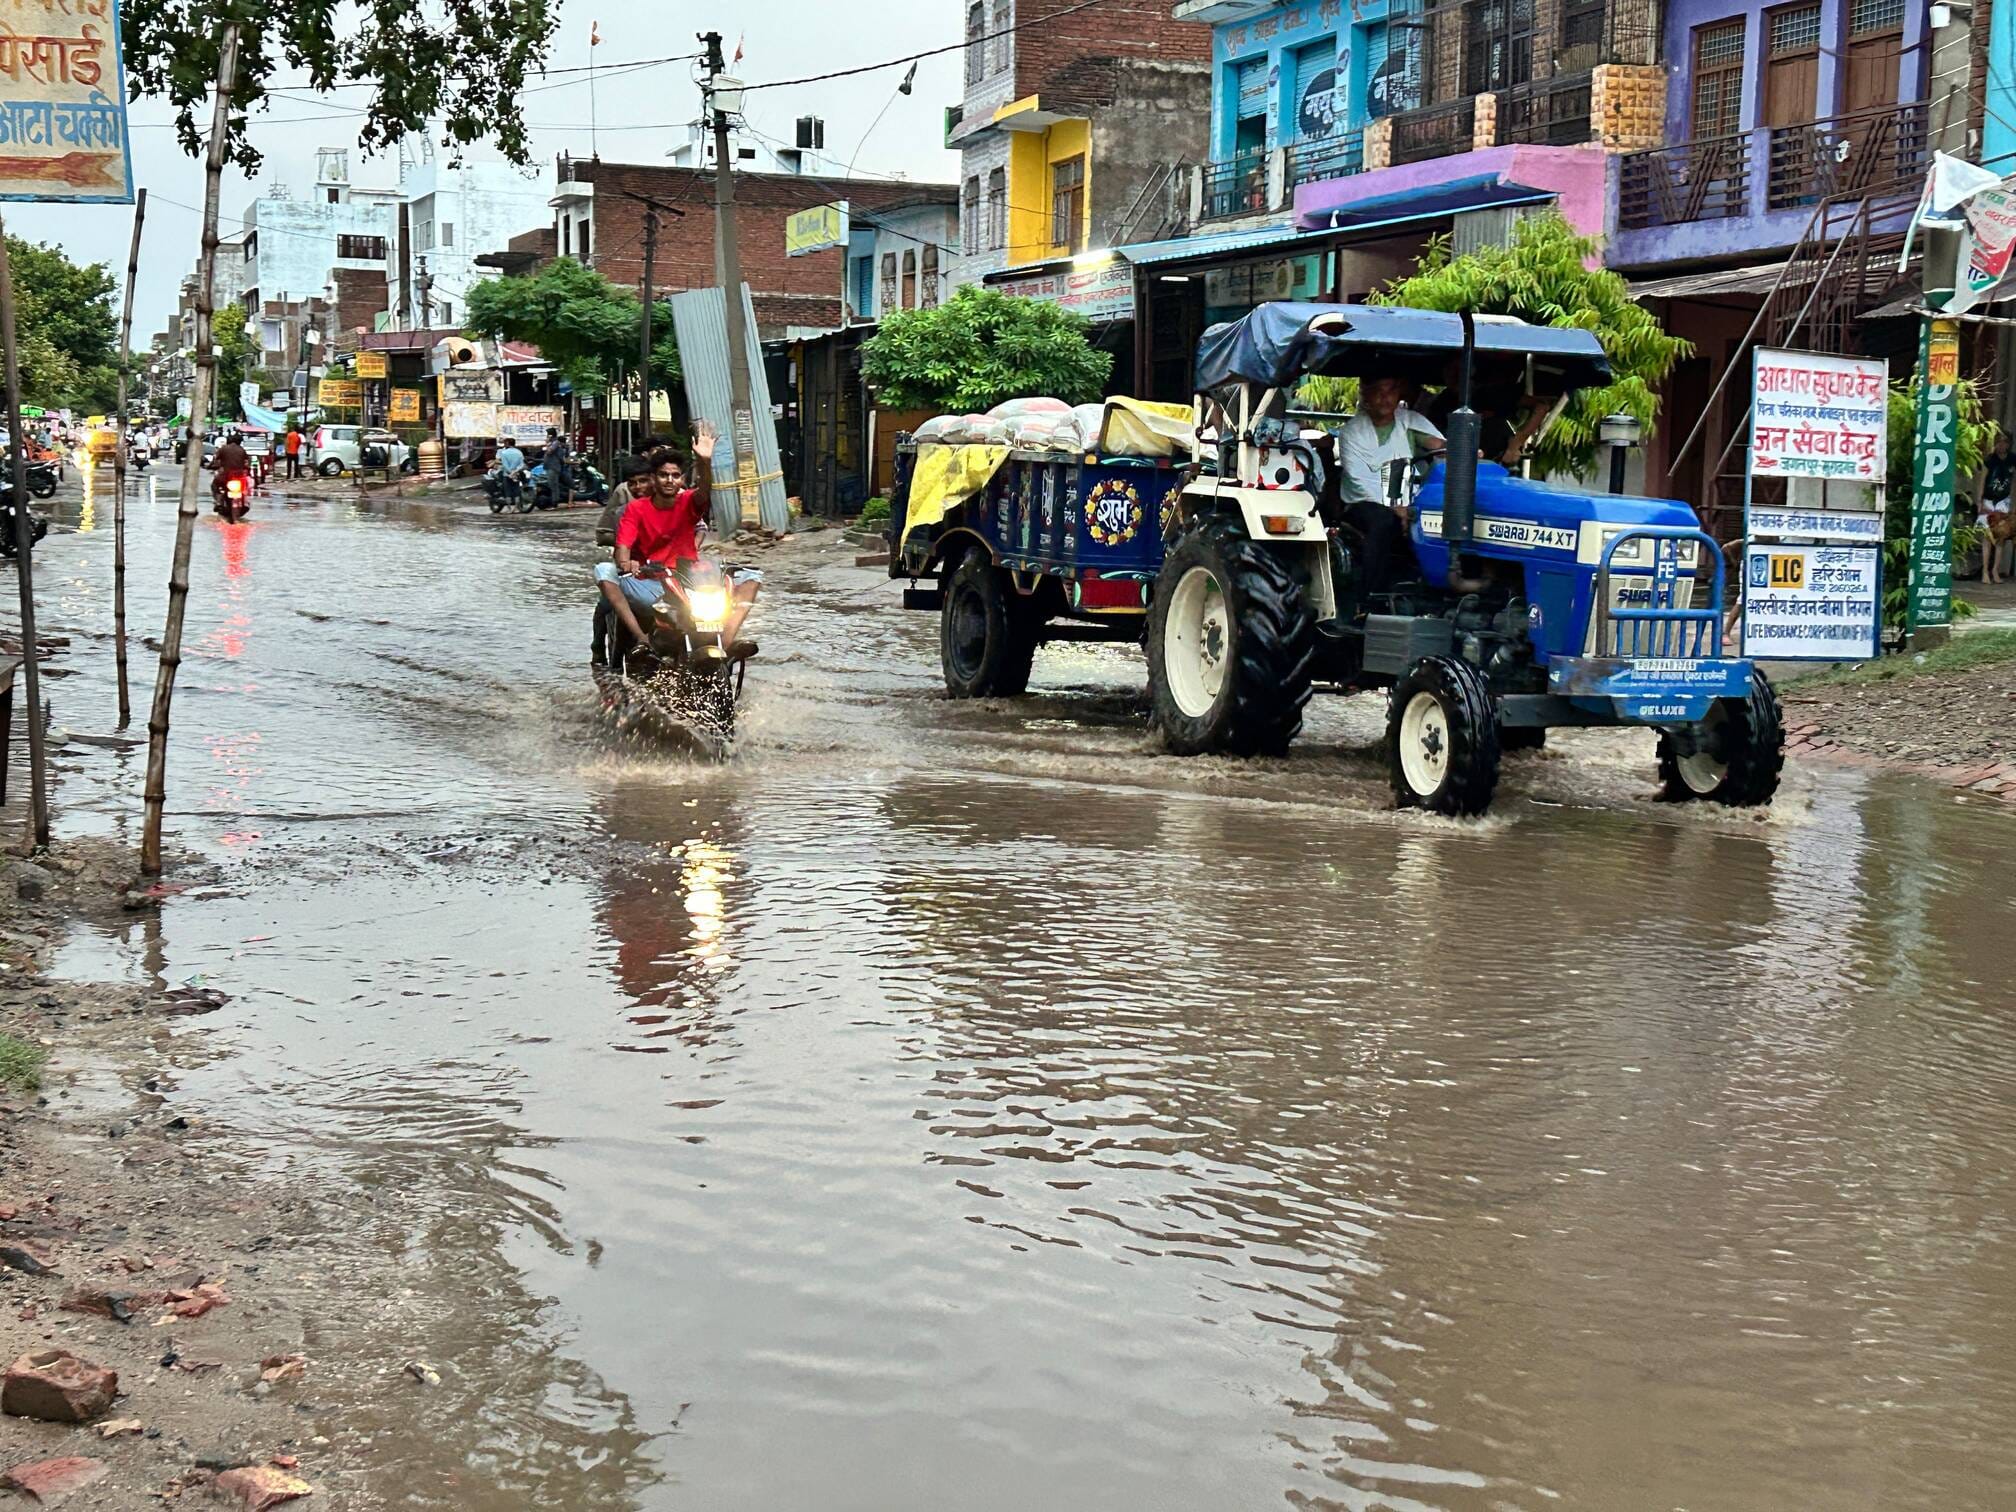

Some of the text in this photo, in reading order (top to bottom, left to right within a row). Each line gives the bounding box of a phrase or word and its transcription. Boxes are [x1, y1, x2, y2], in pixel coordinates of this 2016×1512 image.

[54, 90, 122, 149] चक्की
[1757, 365, 1882, 405] आधार सुधार केन्द्र
[1753, 420, 1878, 460] जन सेवा केन्द्र
[1097, 499, 1131, 531] शुभ
[1532, 529, 1553, 544] 744
[1555, 531, 1574, 546] XT
[1658, 562, 1674, 579] FE
[1771, 559, 1801, 583] LIC
[1812, 563, 1835, 582] हरि
[1748, 593, 1873, 617] भारतीय जीवन बीमा निगम
[1746, 623, 1763, 639] LIFE
[1639, 705, 1686, 716] DELUXE
